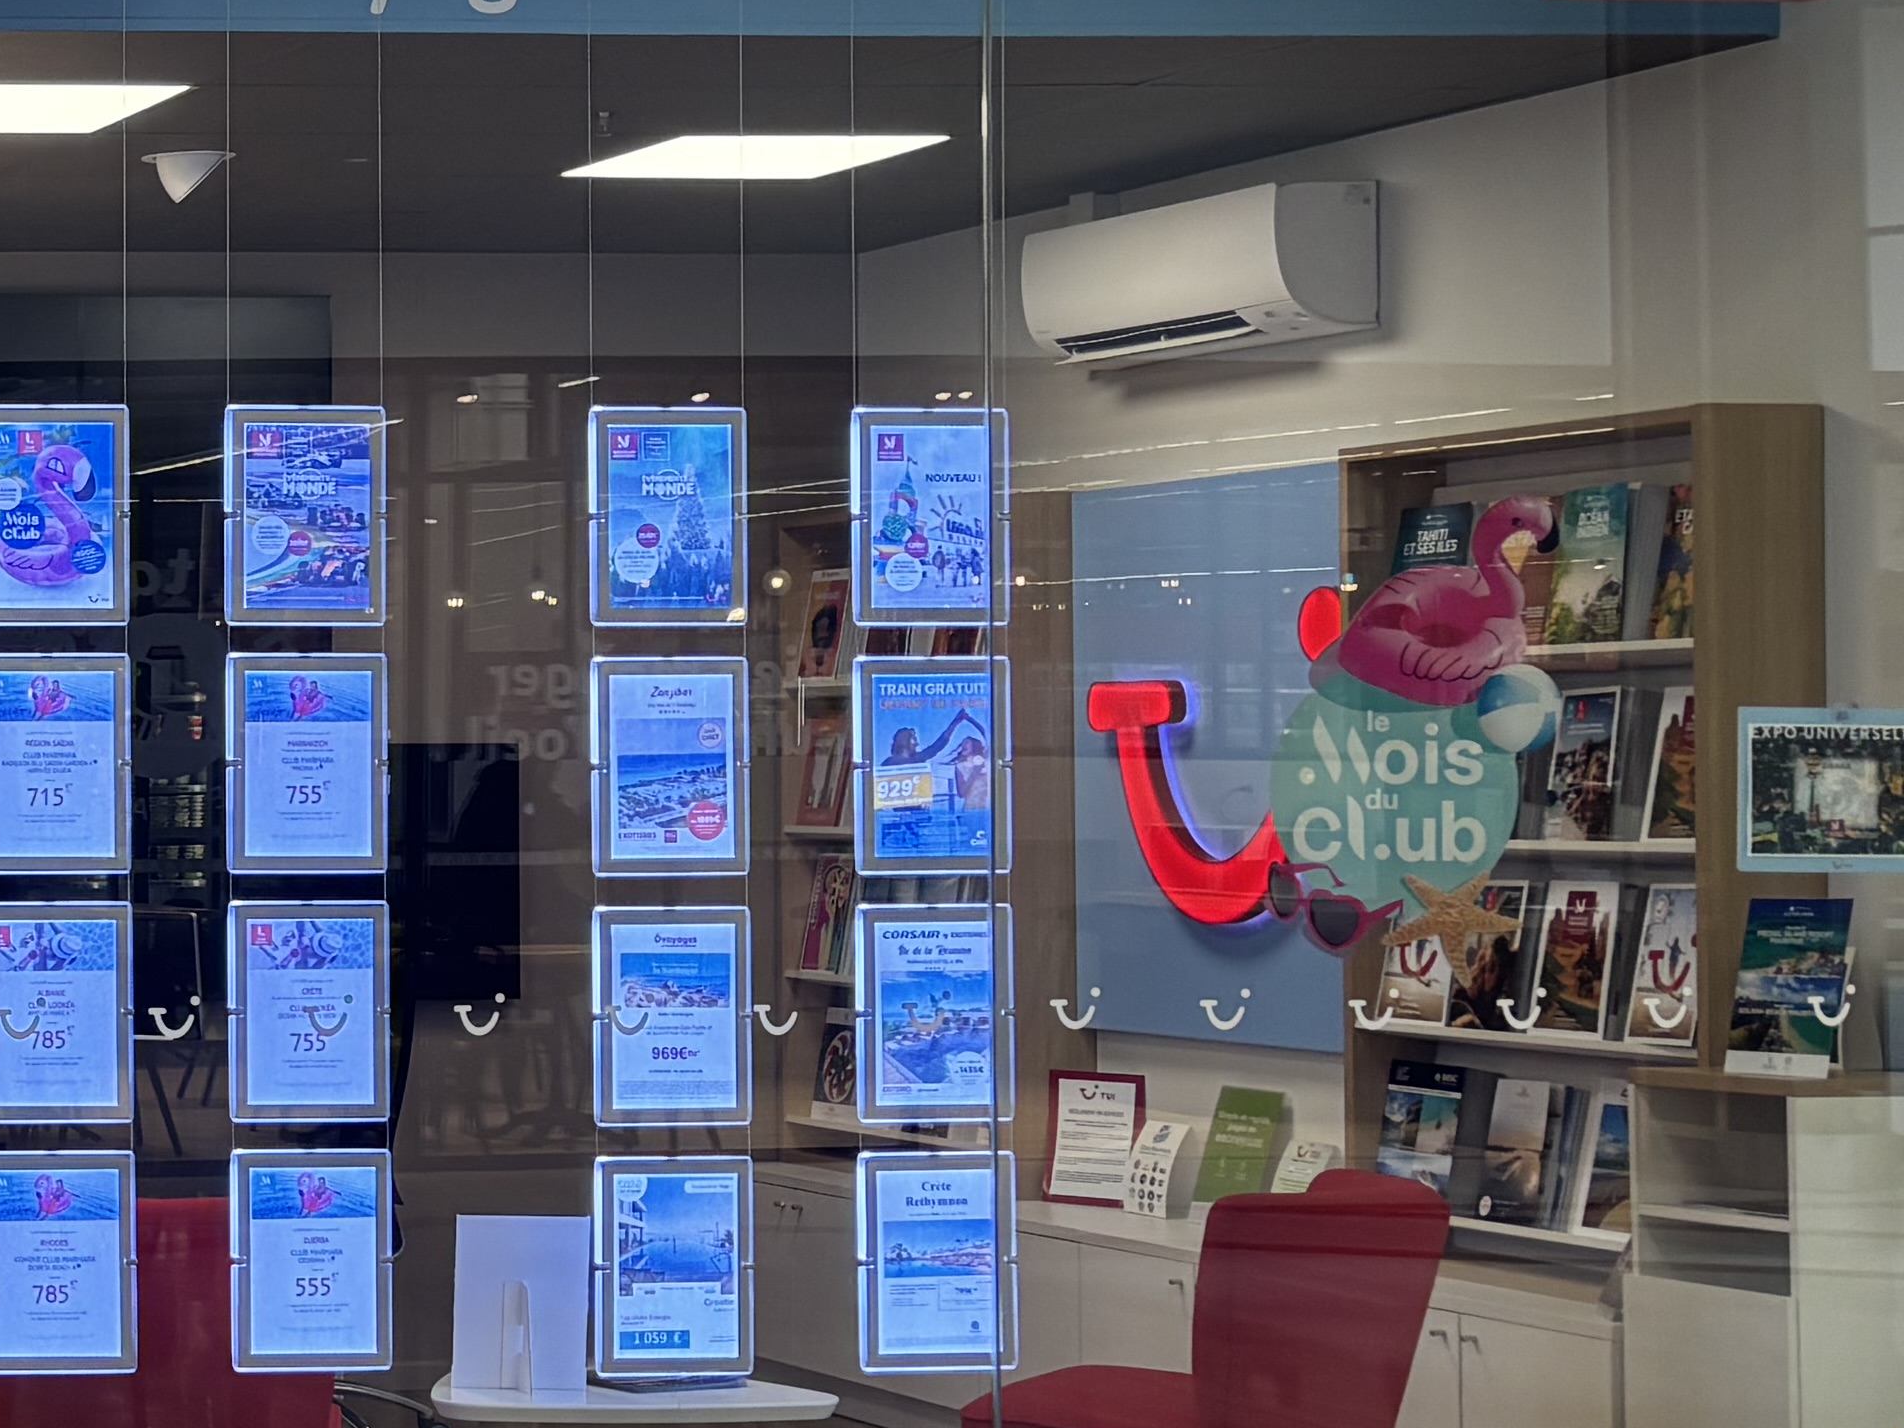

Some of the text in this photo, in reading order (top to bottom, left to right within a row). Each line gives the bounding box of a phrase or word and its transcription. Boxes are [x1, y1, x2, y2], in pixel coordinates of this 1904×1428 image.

[1417, 528, 1449, 542] TAHITI
[1403, 543, 1416, 556] ET
[1416, 541, 1436, 554] SES
[879, 682, 986, 695] TRAIN GRATUIT
[1367, 709, 1390, 732] le
[1365, 790, 1399, 811] du
